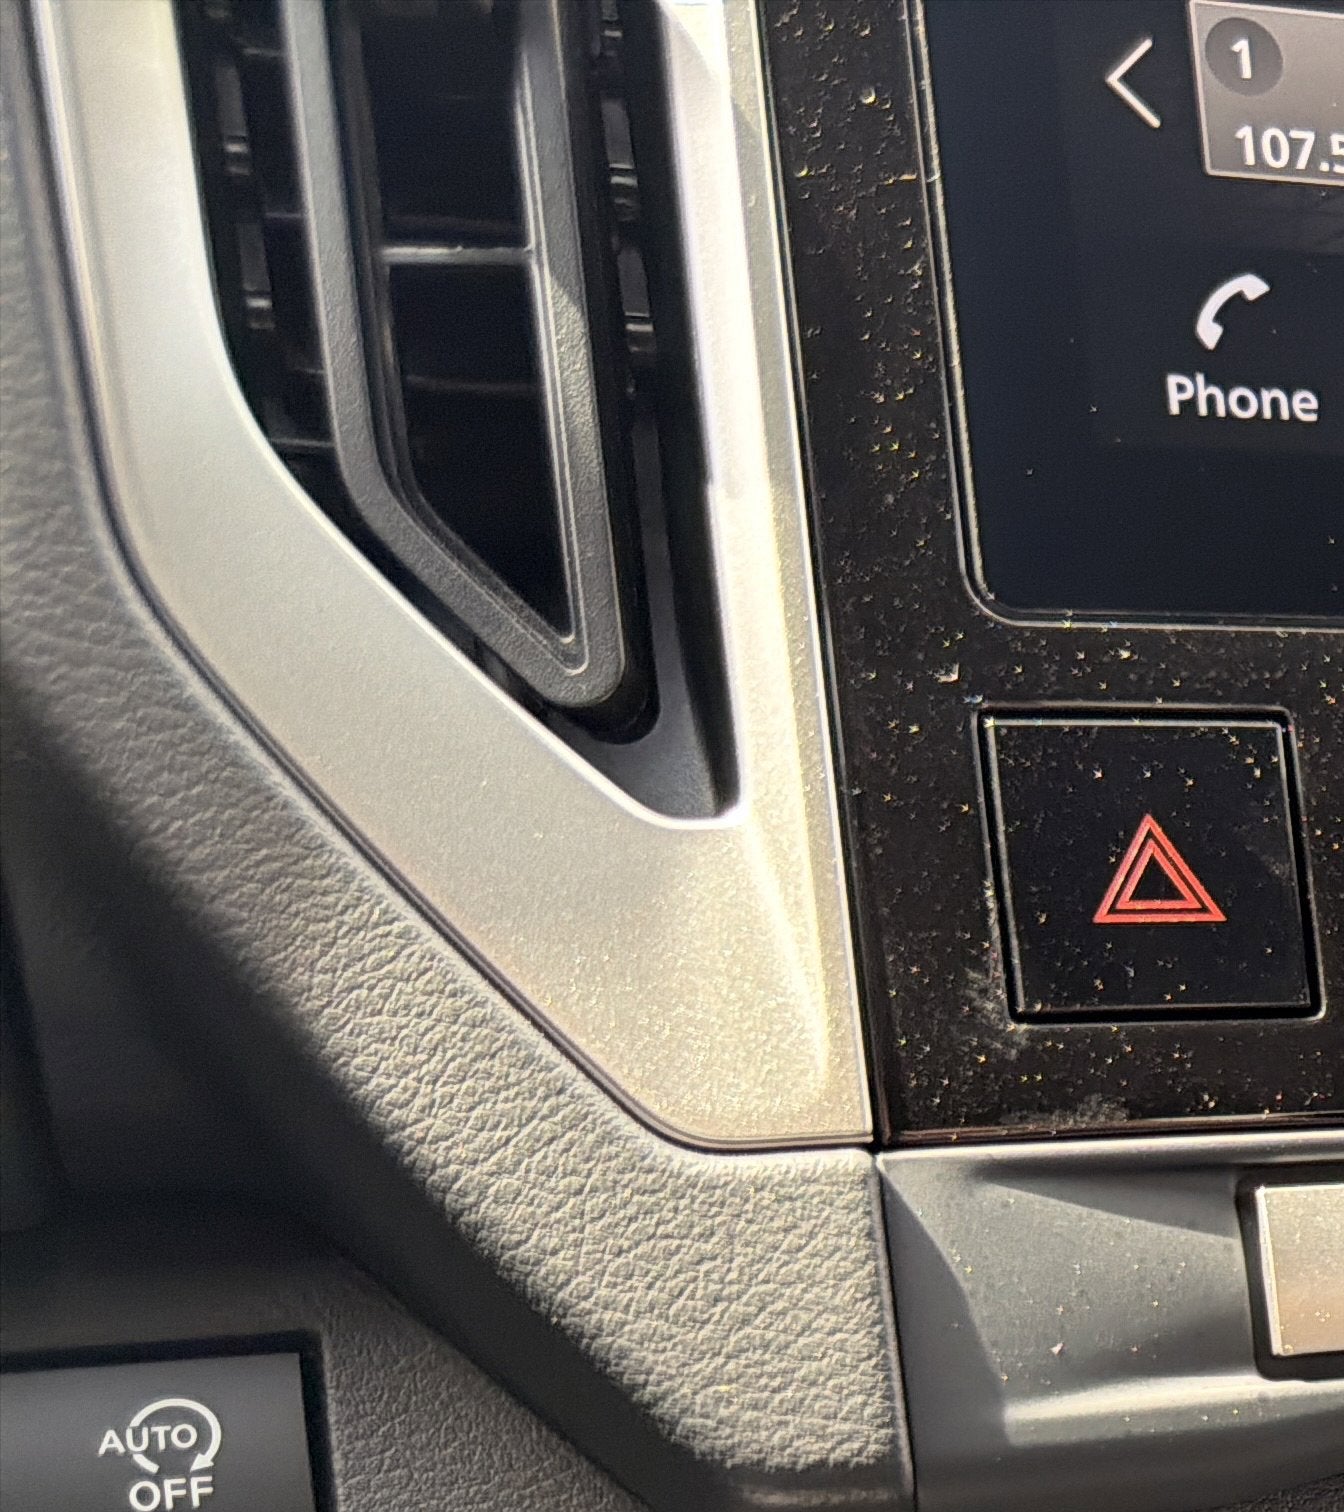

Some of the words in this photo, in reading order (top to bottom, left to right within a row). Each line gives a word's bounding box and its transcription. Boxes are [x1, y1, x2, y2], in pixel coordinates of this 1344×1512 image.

[1231, 39, 1253, 78] 1
[1167, 373, 1319, 424] Phone
[98, 1423, 198, 1456] AUTO
[129, 1475, 214, 1512] OFF
